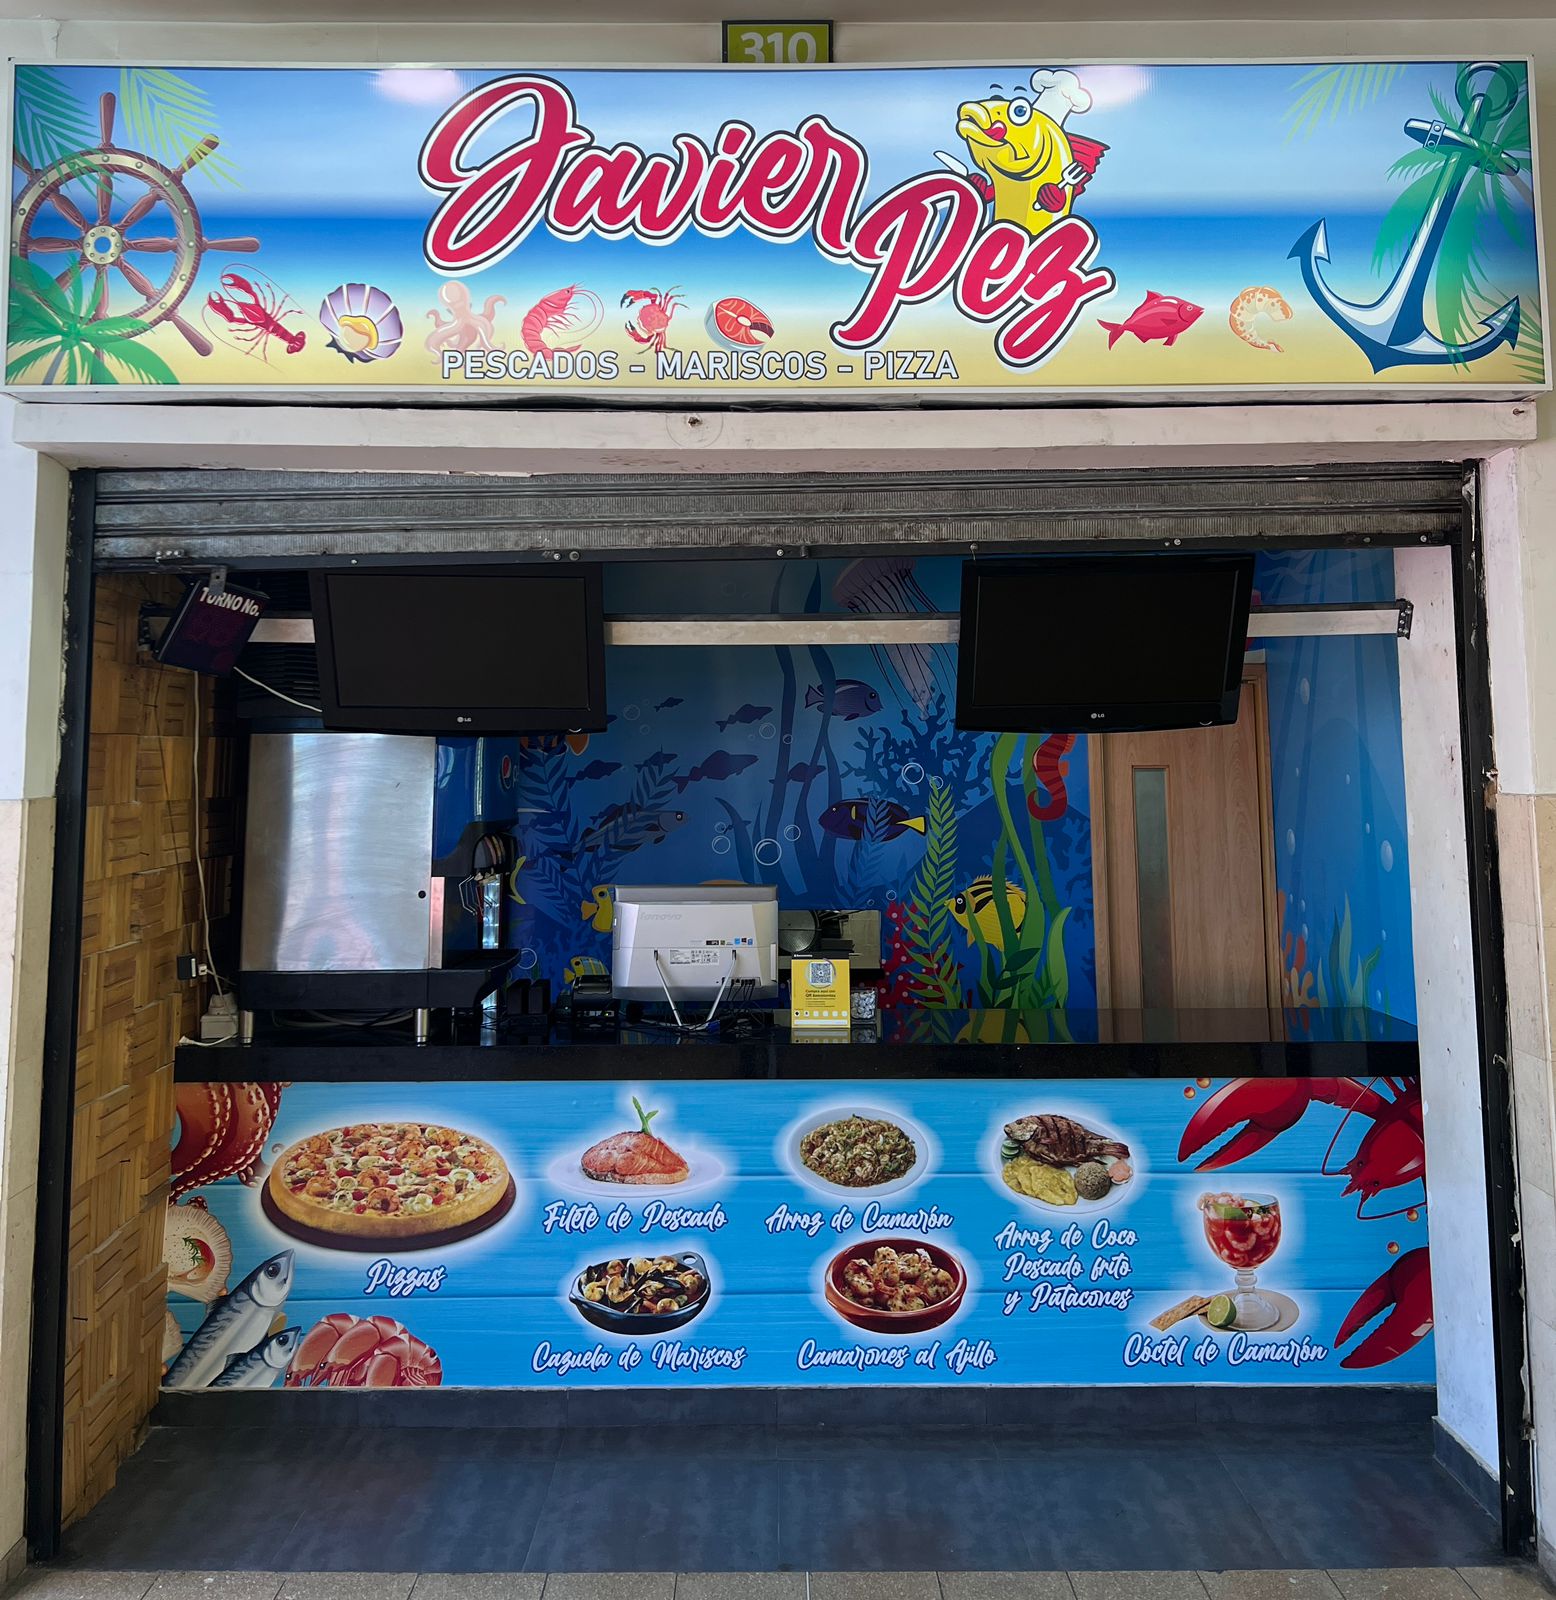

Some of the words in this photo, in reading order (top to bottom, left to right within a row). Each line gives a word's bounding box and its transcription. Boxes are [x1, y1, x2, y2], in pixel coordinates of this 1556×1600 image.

[741, 31, 816, 63] 310
[418, 74, 868, 273] Javier
[829, 170, 1116, 369] Pez
[442, 350, 619, 380] PESCADOS
[656, 350, 827, 380] MARISCOS
[864, 350, 959, 380] PIZZA
[241, 599, 259, 616] No.
[542, 1200, 599, 1233] Filete
[606, 1203, 632, 1232] de
[641, 1201, 728, 1233] Pescado
[765, 1203, 824, 1236] Arroz
[830, 1206, 853, 1231] de
[860, 1201, 953, 1234] Camarón
[994, 1220, 1054, 1253] Arroz
[1059, 1223, 1083, 1248] de
[1090, 1218, 1139, 1248] Coco
[364, 1258, 448, 1298] Pizzas
[1003, 1252, 1084, 1282] Pescado
[1090, 1254, 1132, 1283] frito
[1002, 1289, 1021, 1316] y
[1029, 1282, 1136, 1312] Patacones
[531, 1341, 611, 1376] Cazuela
[618, 1342, 642, 1370] de
[651, 1341, 748, 1375] Mariscos
[797, 1338, 908, 1371] Camarones
[914, 1340, 940, 1367] al
[945, 1337, 998, 1374] Ajillo
[1123, 1331, 1189, 1367] Cóctel
[1193, 1336, 1218, 1363] de
[1227, 1331, 1328, 1367] Camarón
